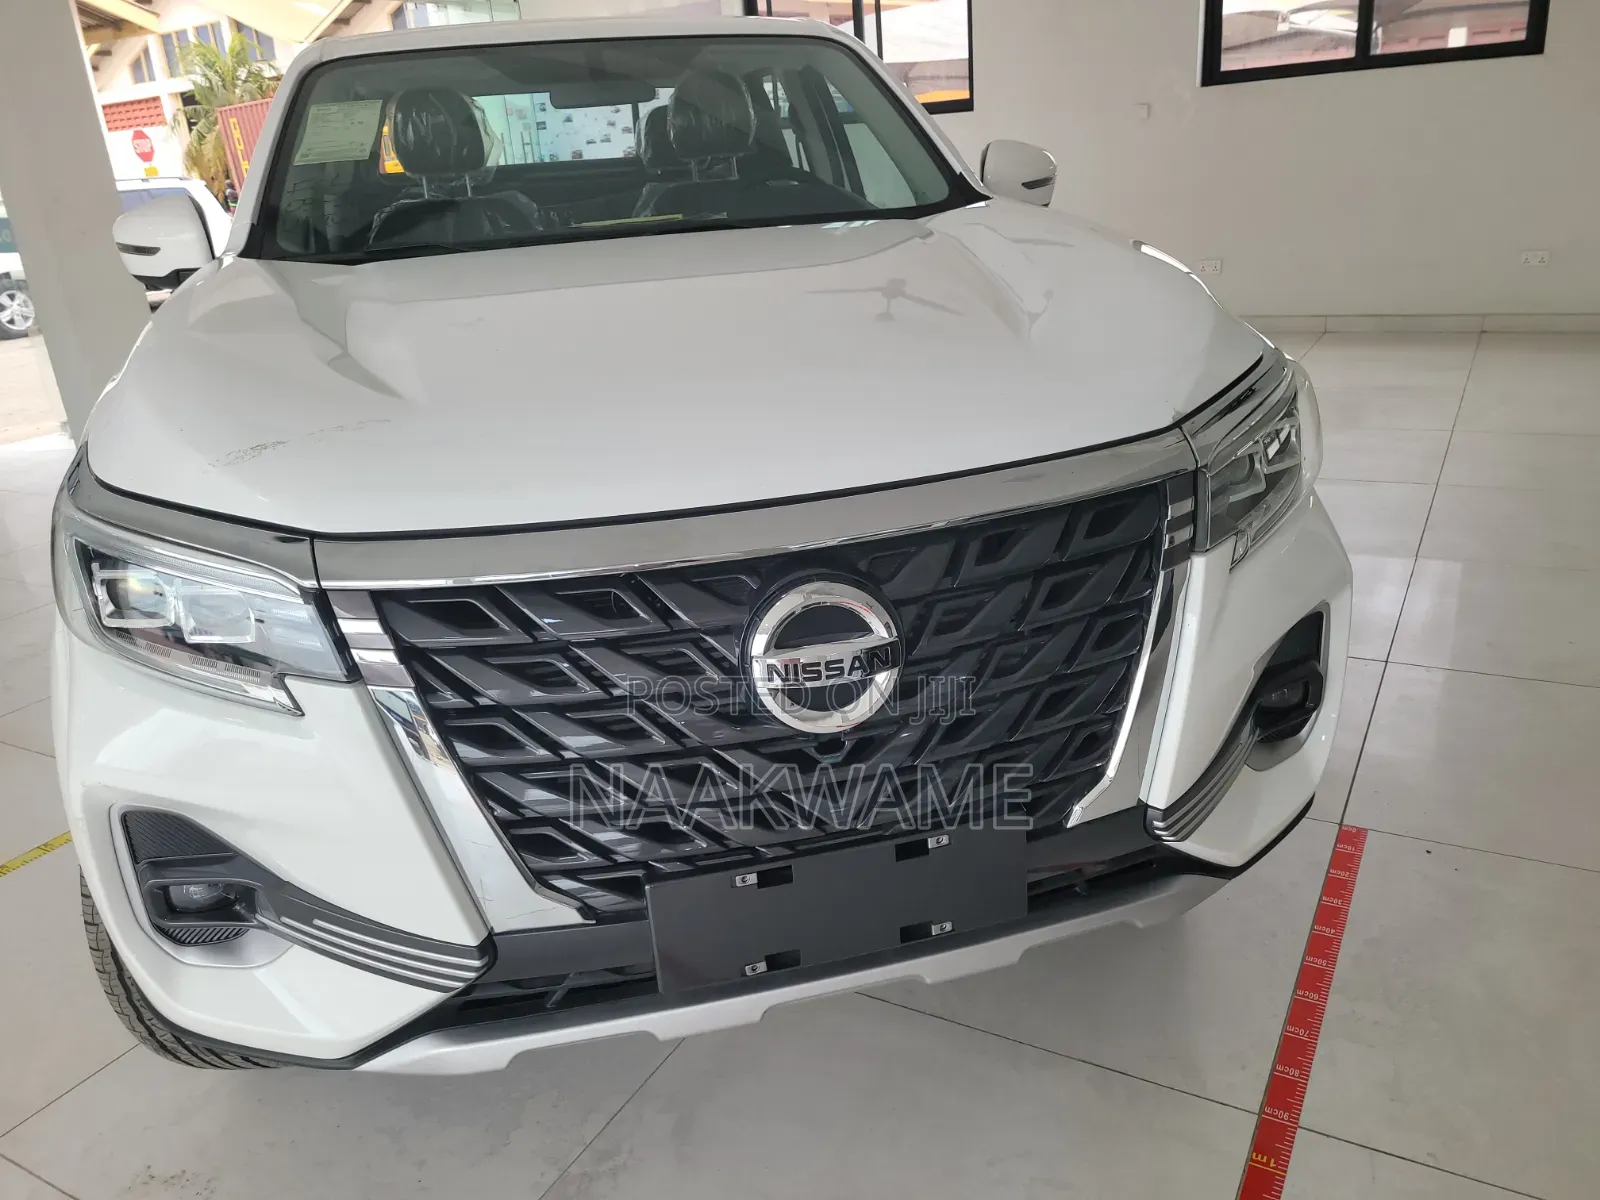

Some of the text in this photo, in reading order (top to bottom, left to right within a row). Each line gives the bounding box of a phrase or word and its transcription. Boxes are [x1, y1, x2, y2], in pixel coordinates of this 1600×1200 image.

[133, 138, 153, 154] STOP
[766, 646, 892, 683] NISSAN
[1336, 843, 1356, 852] 10cm
[1329, 868, 1350, 878] 20cm
[1322, 895, 1343, 906] 30cm
[1314, 924, 1336, 935] 40cm
[1305, 955, 1328, 967] 50cm
[1296, 989, 1319, 1001] 60cm
[1286, 1025, 1310, 1038] 70cm
[1275, 1063, 1300, 1077] 80cm
[1264, 1106, 1290, 1121] 90cm
